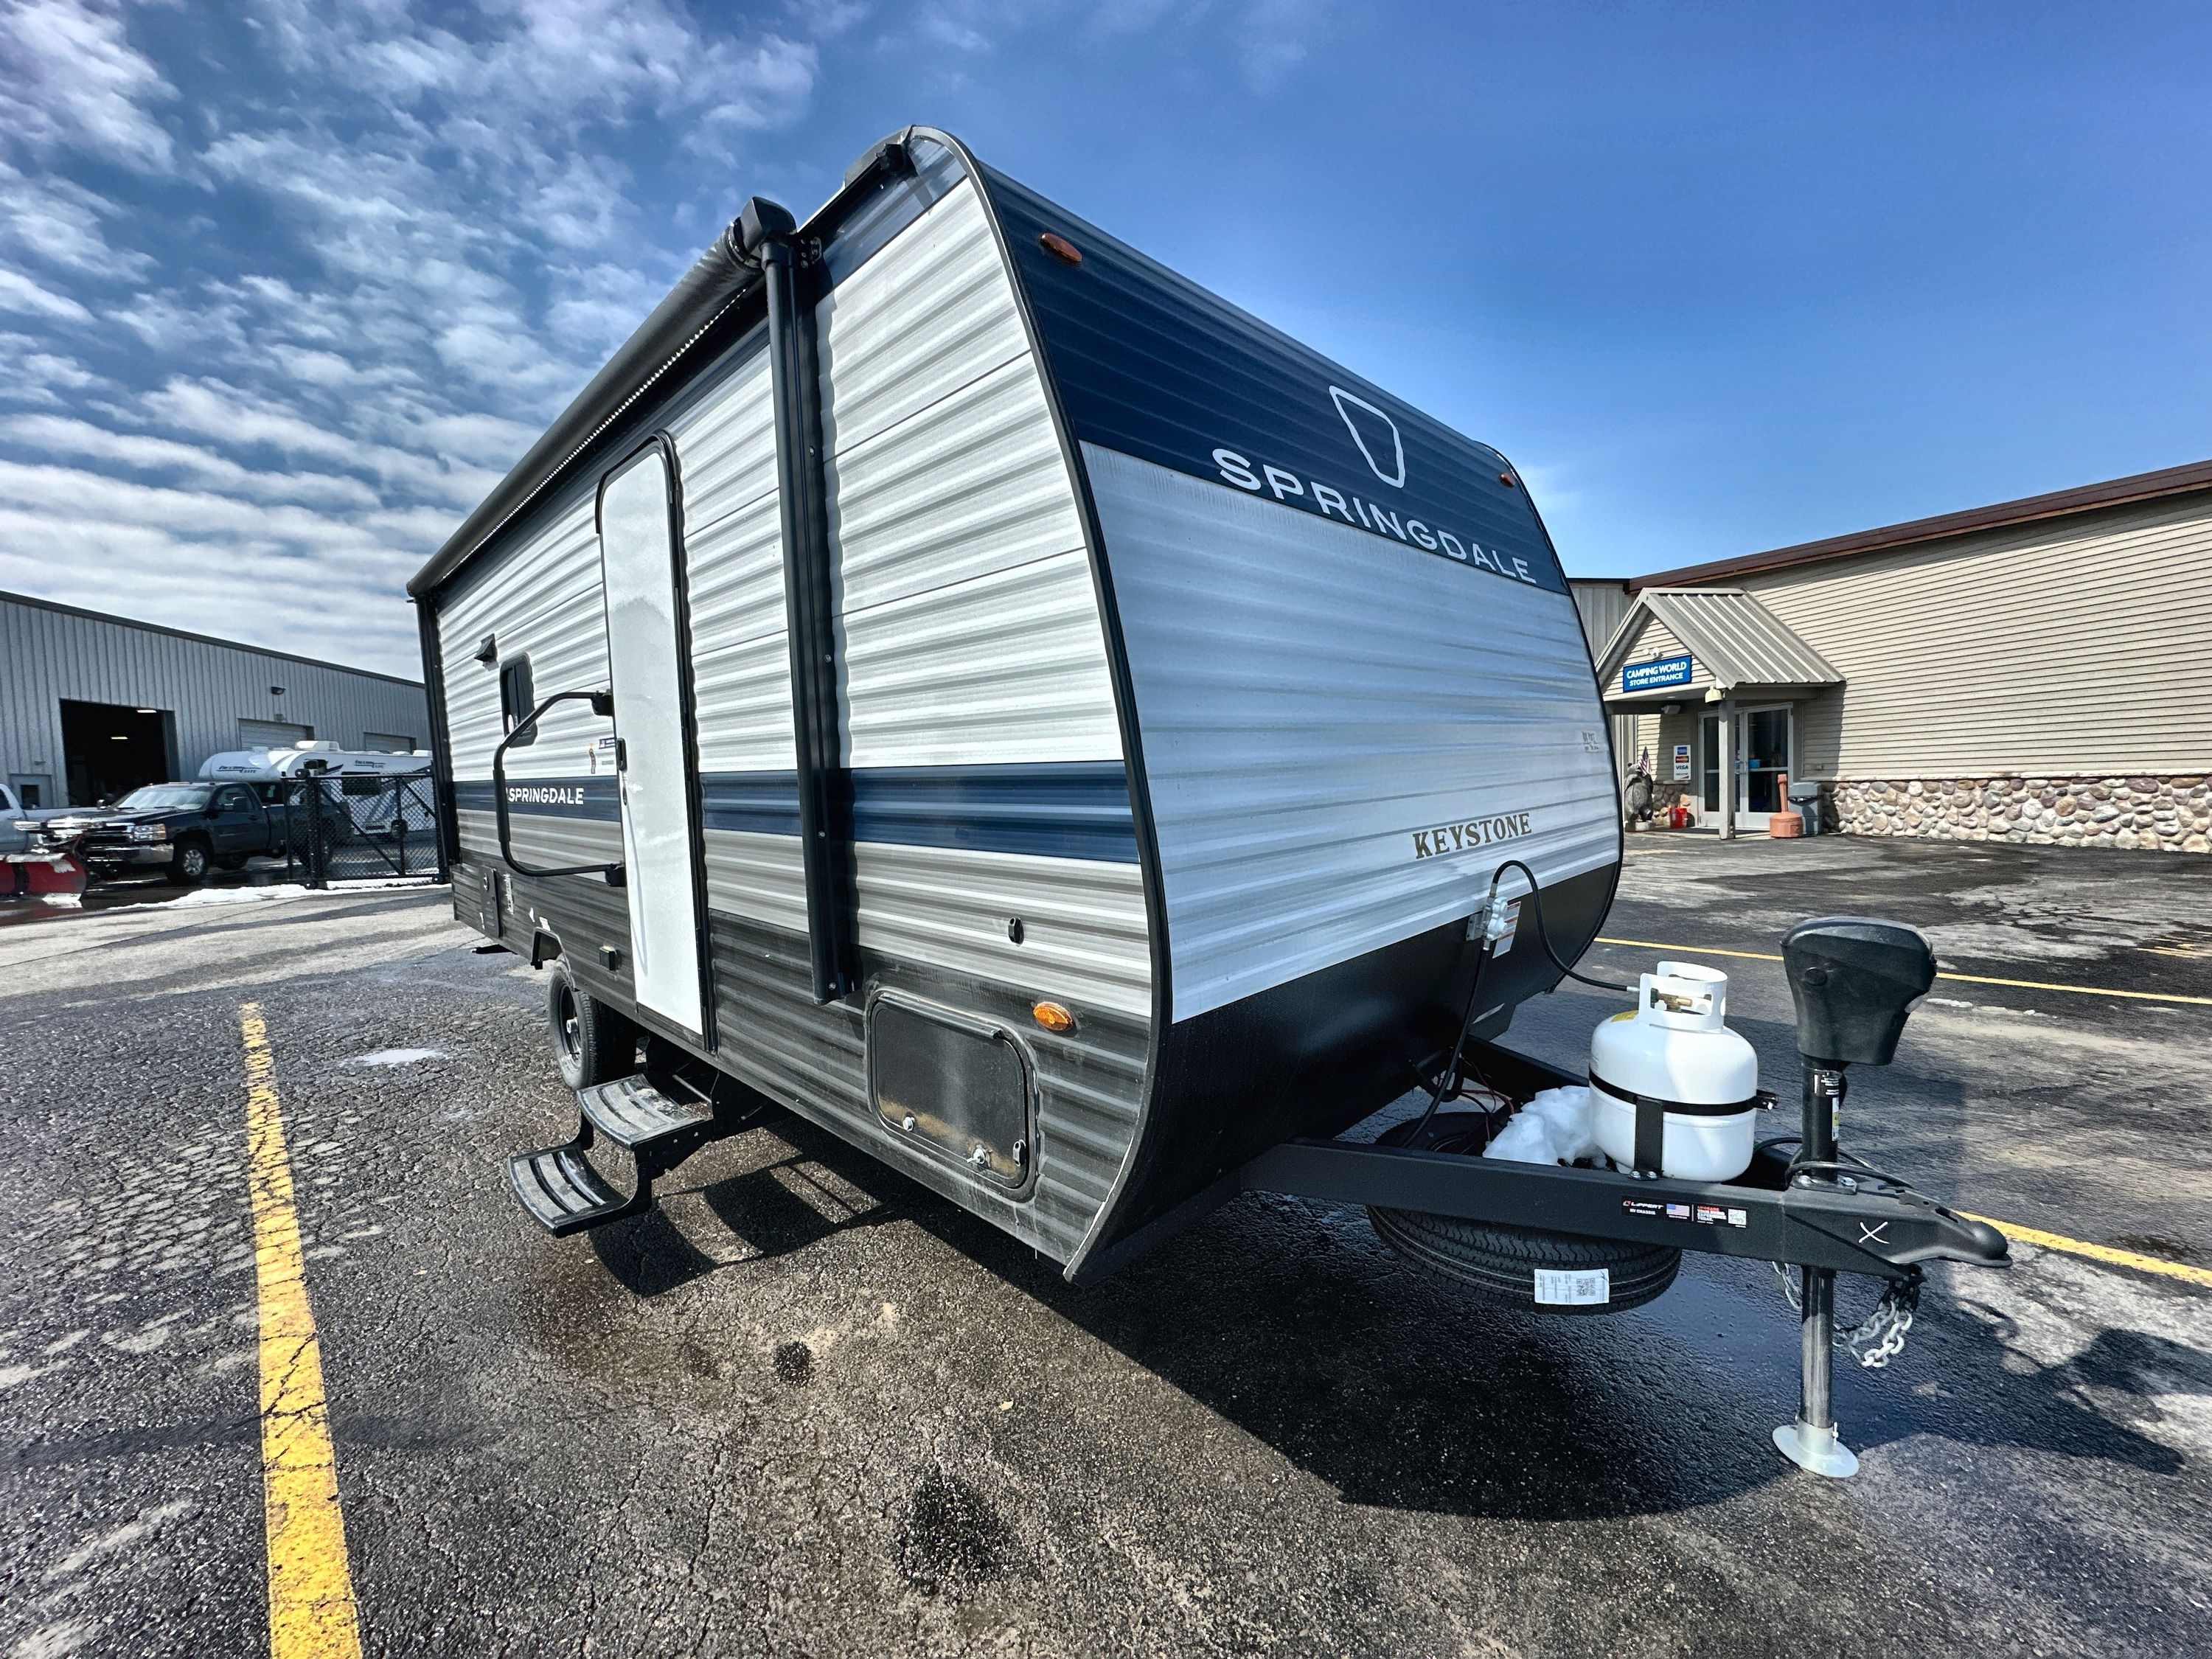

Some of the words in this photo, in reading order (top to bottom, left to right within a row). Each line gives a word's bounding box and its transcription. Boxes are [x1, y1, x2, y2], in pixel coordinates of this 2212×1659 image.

[1211, 448, 1537, 584] SPRINGDALE
[1626, 666, 1658, 679] CAMPING
[1659, 661, 1687, 674] WORLD
[1630, 678, 1649, 686] STORE
[1649, 672, 1683, 684] ENTRANCE
[508, 787, 585, 804] SPRINGDALE
[1413, 813, 1532, 859] KEYSTONE
